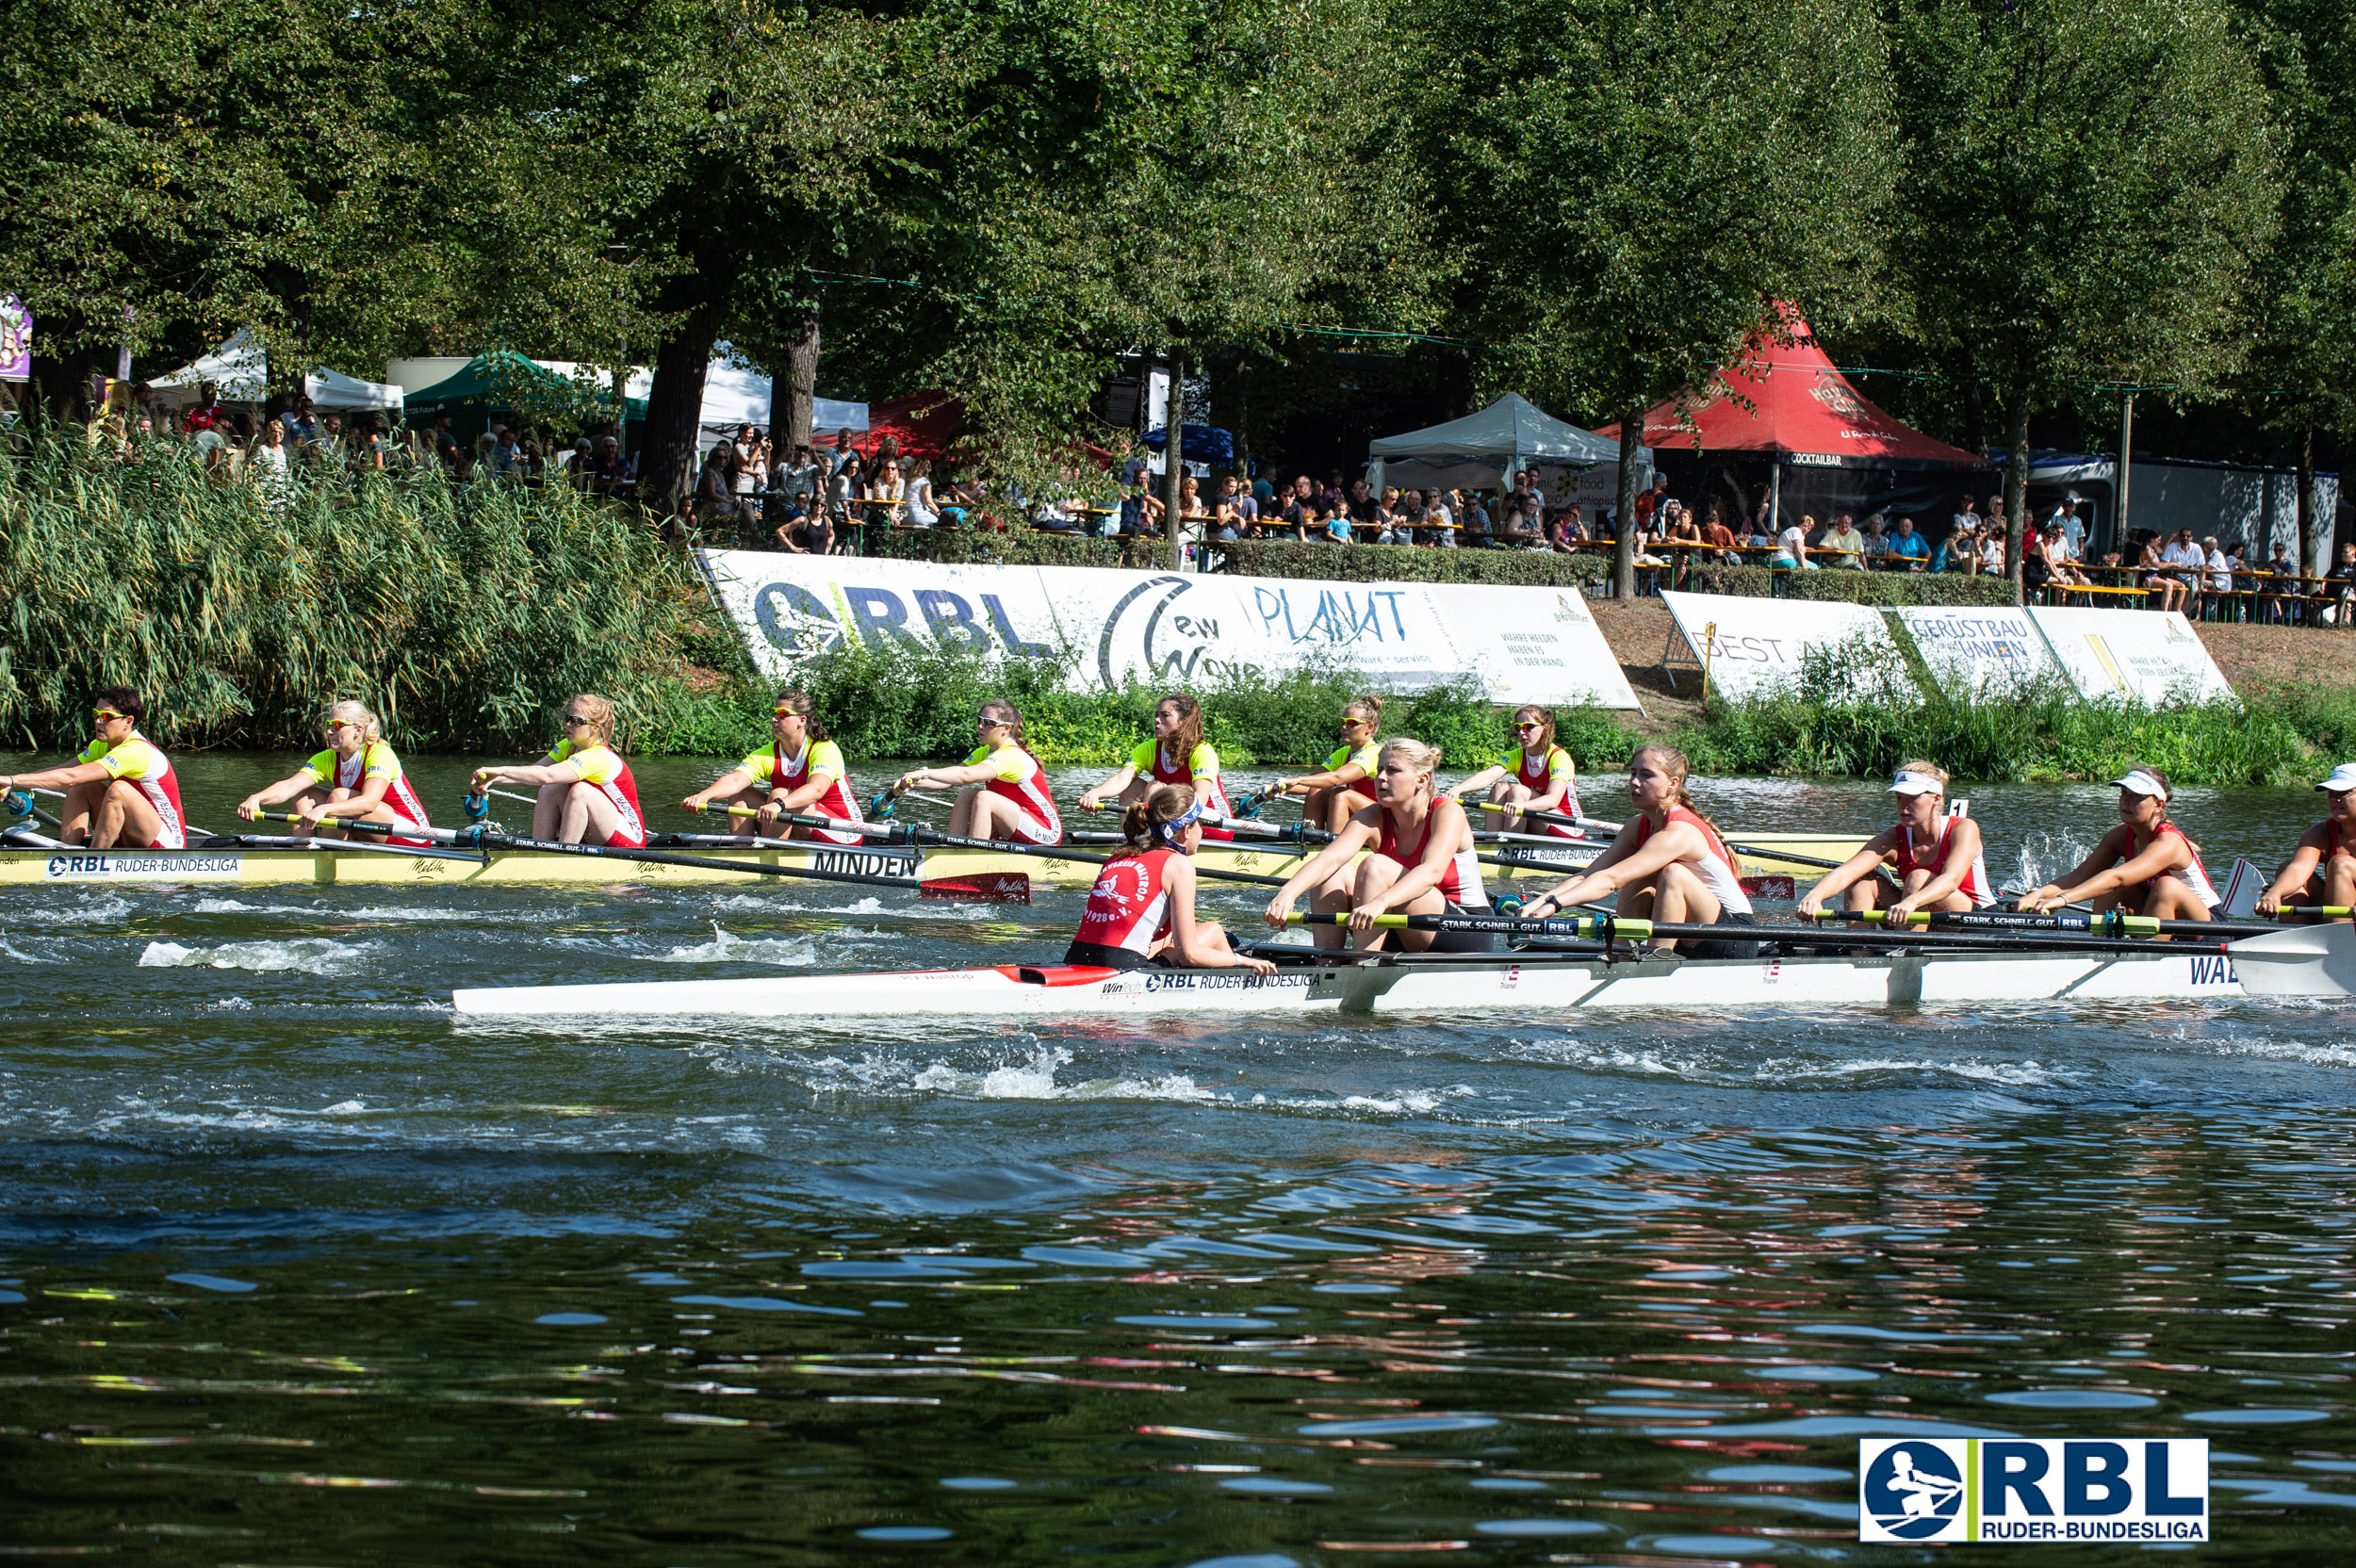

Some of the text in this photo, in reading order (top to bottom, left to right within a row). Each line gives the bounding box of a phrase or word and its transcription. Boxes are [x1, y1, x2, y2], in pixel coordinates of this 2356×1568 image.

[1791, 452, 1842, 466] COCKTAILBAR
[1580, 473, 1605, 490] food
[843, 586, 1055, 658] RBL
[1254, 586, 1405, 646] PLANAT
[1911, 614, 2028, 638] GERÜSTBAU
[1500, 633, 1559, 644] WAHRE HELDEN
[1507, 645, 1546, 655] HABEN ES
[1692, 631, 1785, 663] BEST
[1396, 654, 1432, 664] service
[1513, 658, 1566, 668] IN DER HAND.
[1954, 802, 1961, 816] 1
[537, 841, 565, 850] SCHNELL.
[967, 839, 994, 848] SCHNELL.
[1512, 847, 1537, 860] RBL
[0, 857, 19, 865] nden
[70, 857, 109, 872] RBL
[115, 858, 237, 873] RUDER-BUNDESLIGA
[406, 857, 447, 874] Melitta
[629, 861, 666, 874] Melitta
[814, 852, 918, 877] MINDEN
[993, 876, 1025, 892] Melitta
[1134, 861, 1150, 902] WALTROP
[1086, 911, 1108, 923] 1928
[1963, 916, 1992, 924] STARK.
[1994, 918, 2035, 926] SCHNELL.
[2036, 919, 2056, 927] GUT.
[2063, 919, 2086, 927] RBL
[1442, 920, 1574, 933] STARK. SCHNELL. GUT. RBL
[1102, 980, 1141, 993] WinTech
[1162, 972, 1320, 989] RBL RUDER-BUNDESLIGA
